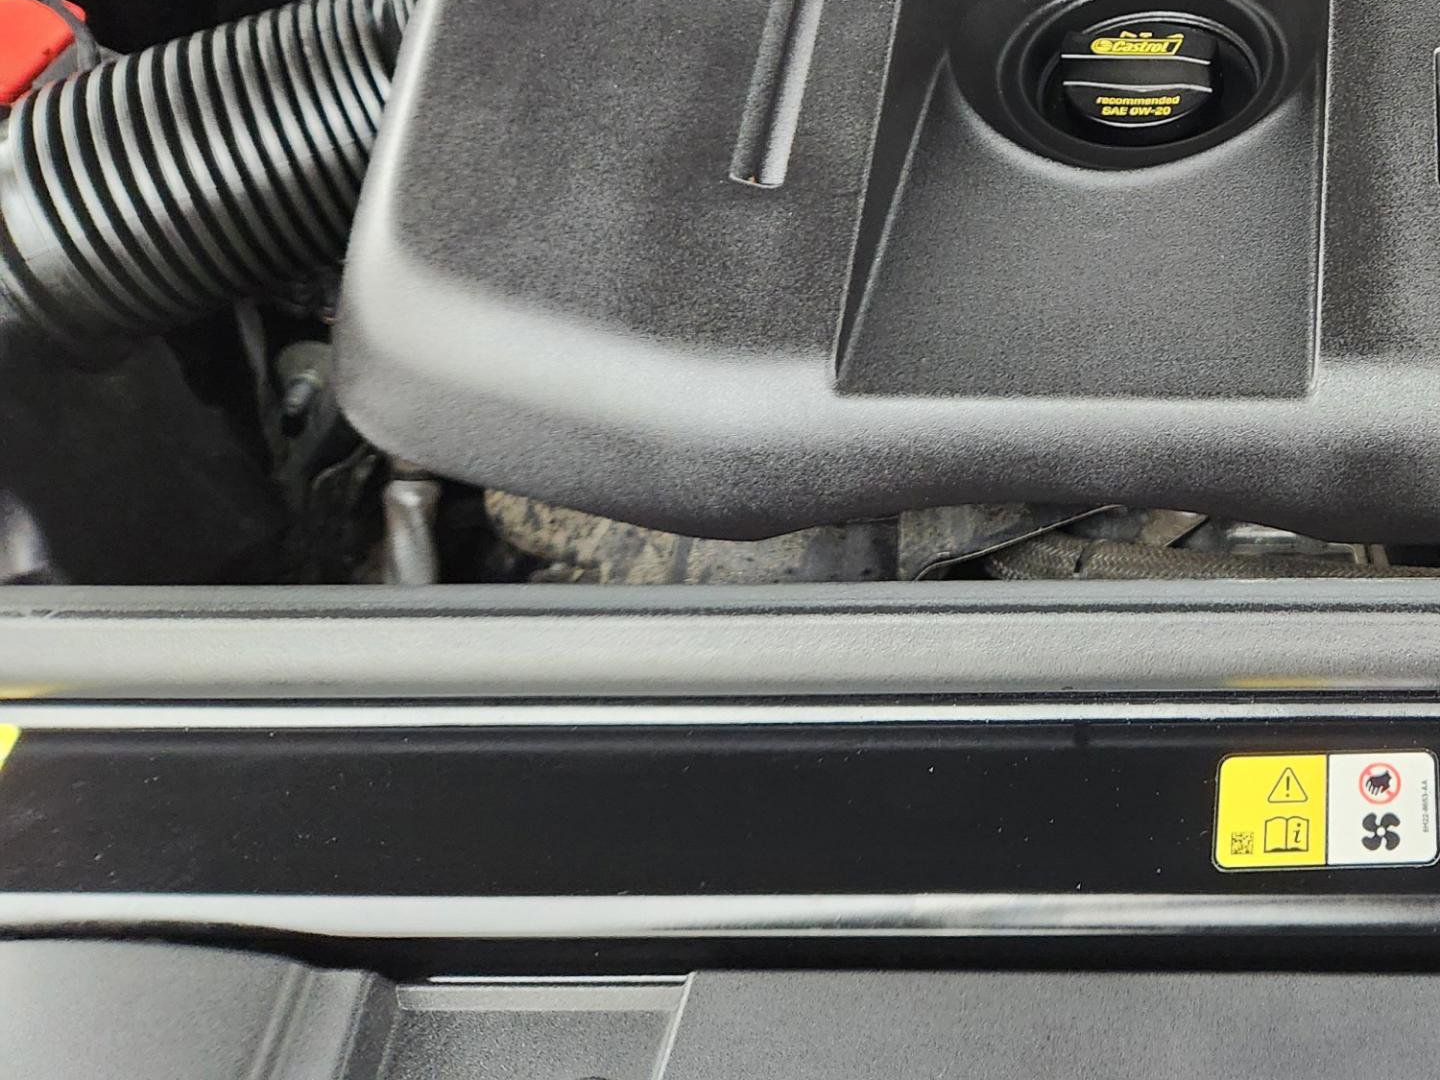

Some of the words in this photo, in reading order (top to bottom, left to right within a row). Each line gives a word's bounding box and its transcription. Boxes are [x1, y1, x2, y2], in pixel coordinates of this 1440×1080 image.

[1111, 41, 1169, 54] Castrol
[1095, 96, 1181, 106] recommended
[1101, 106, 1129, 116] SAE
[1129, 106, 1172, 116] 0W-20
